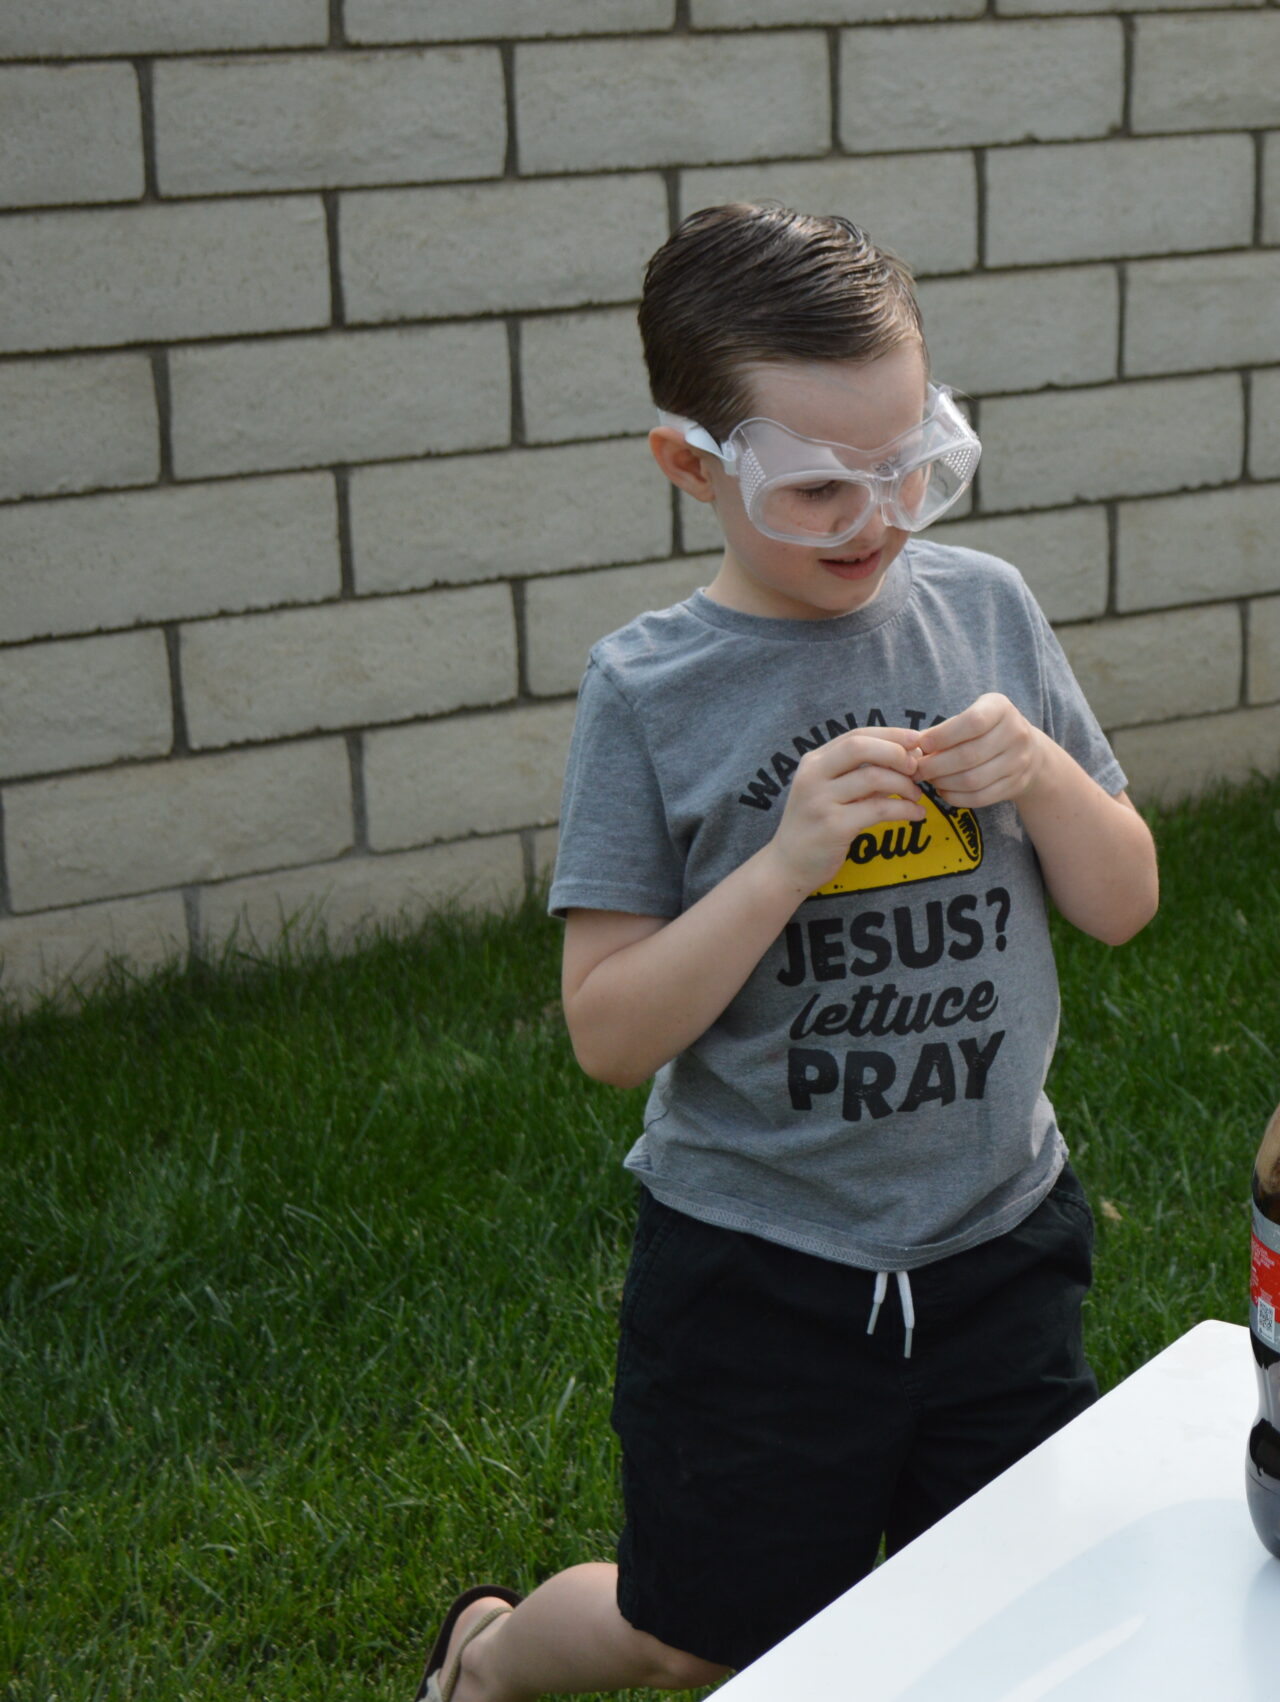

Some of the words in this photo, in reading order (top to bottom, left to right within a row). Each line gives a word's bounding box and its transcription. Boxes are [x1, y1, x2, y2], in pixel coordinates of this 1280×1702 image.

[739, 708, 886, 812] WANNA
[846, 818, 932, 865] out
[777, 887, 1011, 987] JESUS?
[789, 980, 999, 1041] lettuce
[787, 1030, 1006, 1122] PRAY
